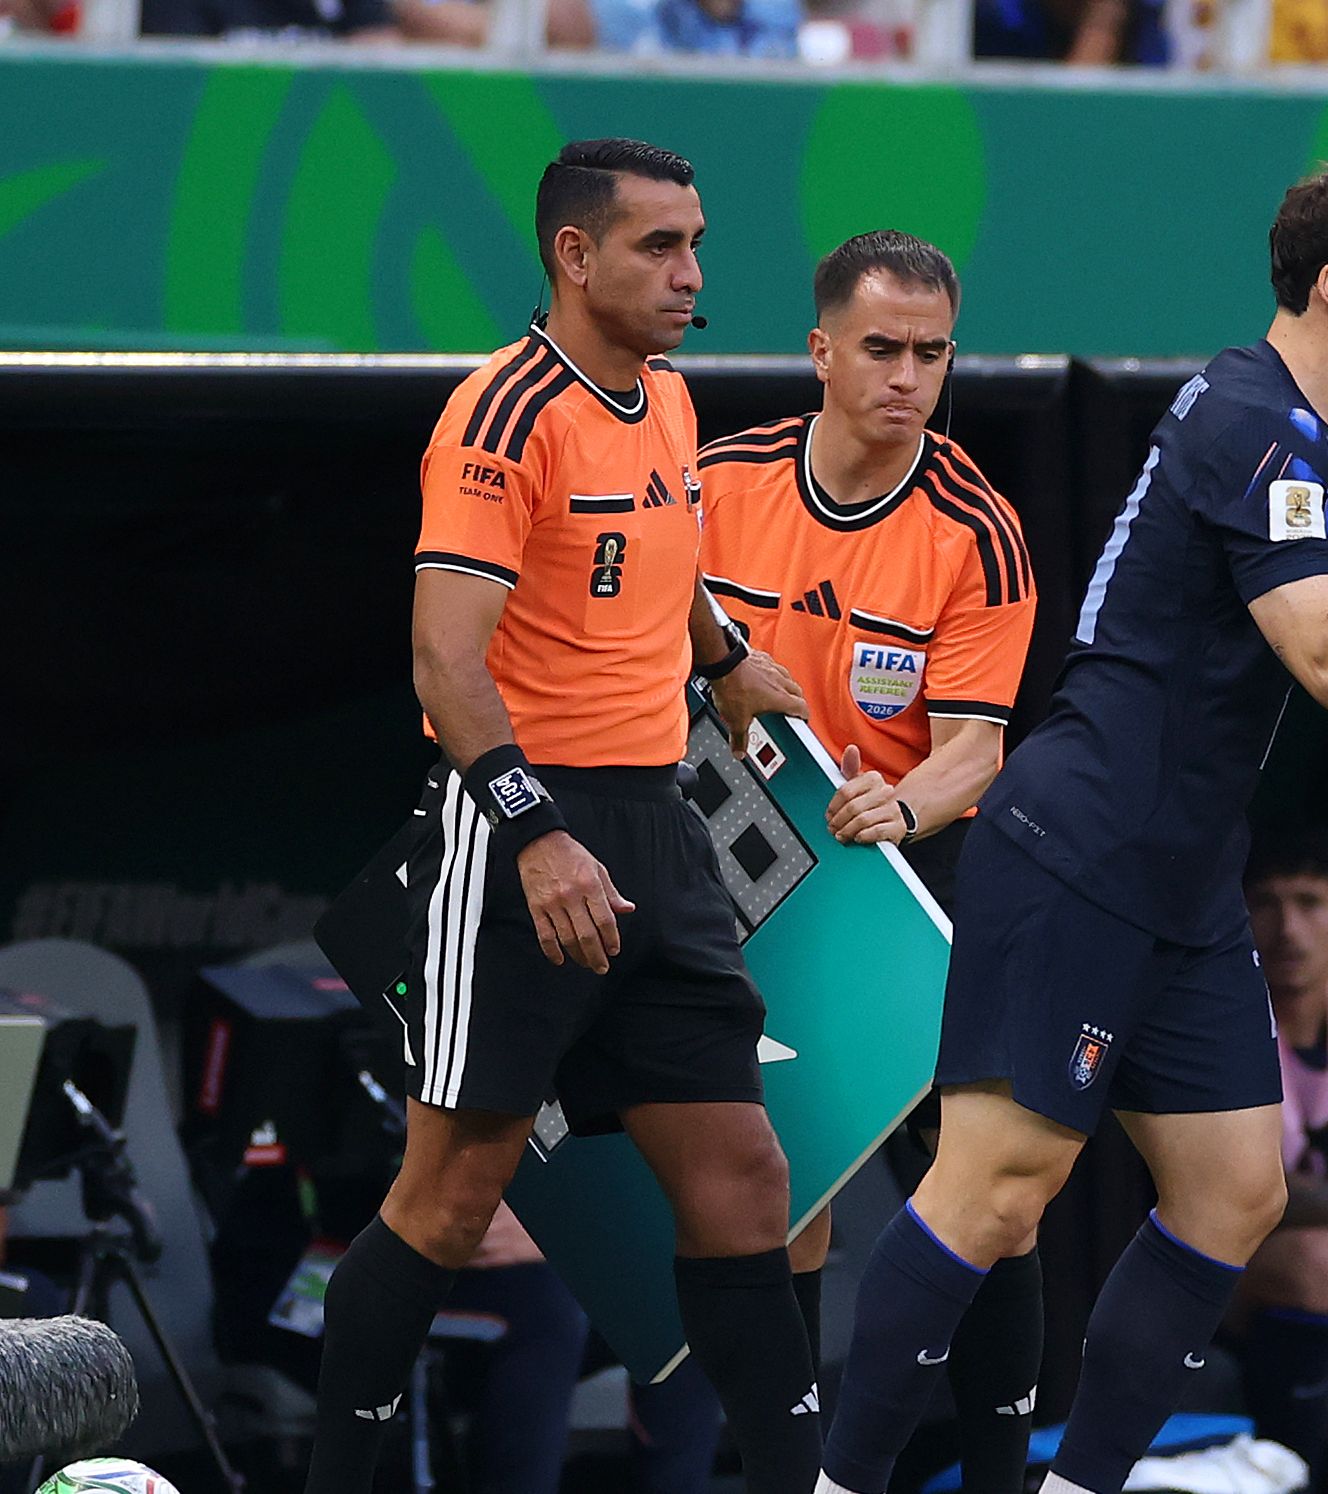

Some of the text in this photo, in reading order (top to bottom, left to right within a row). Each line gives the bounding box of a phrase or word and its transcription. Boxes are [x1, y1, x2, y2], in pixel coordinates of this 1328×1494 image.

[461, 463, 505, 490] FIFA
[597, 584, 613, 592] FIFA
[859, 650, 917, 674] FIFA
[858, 676, 914, 687] ASSISTANT
[860, 685, 907, 696] REFEREE
[867, 704, 894, 715] 2026
